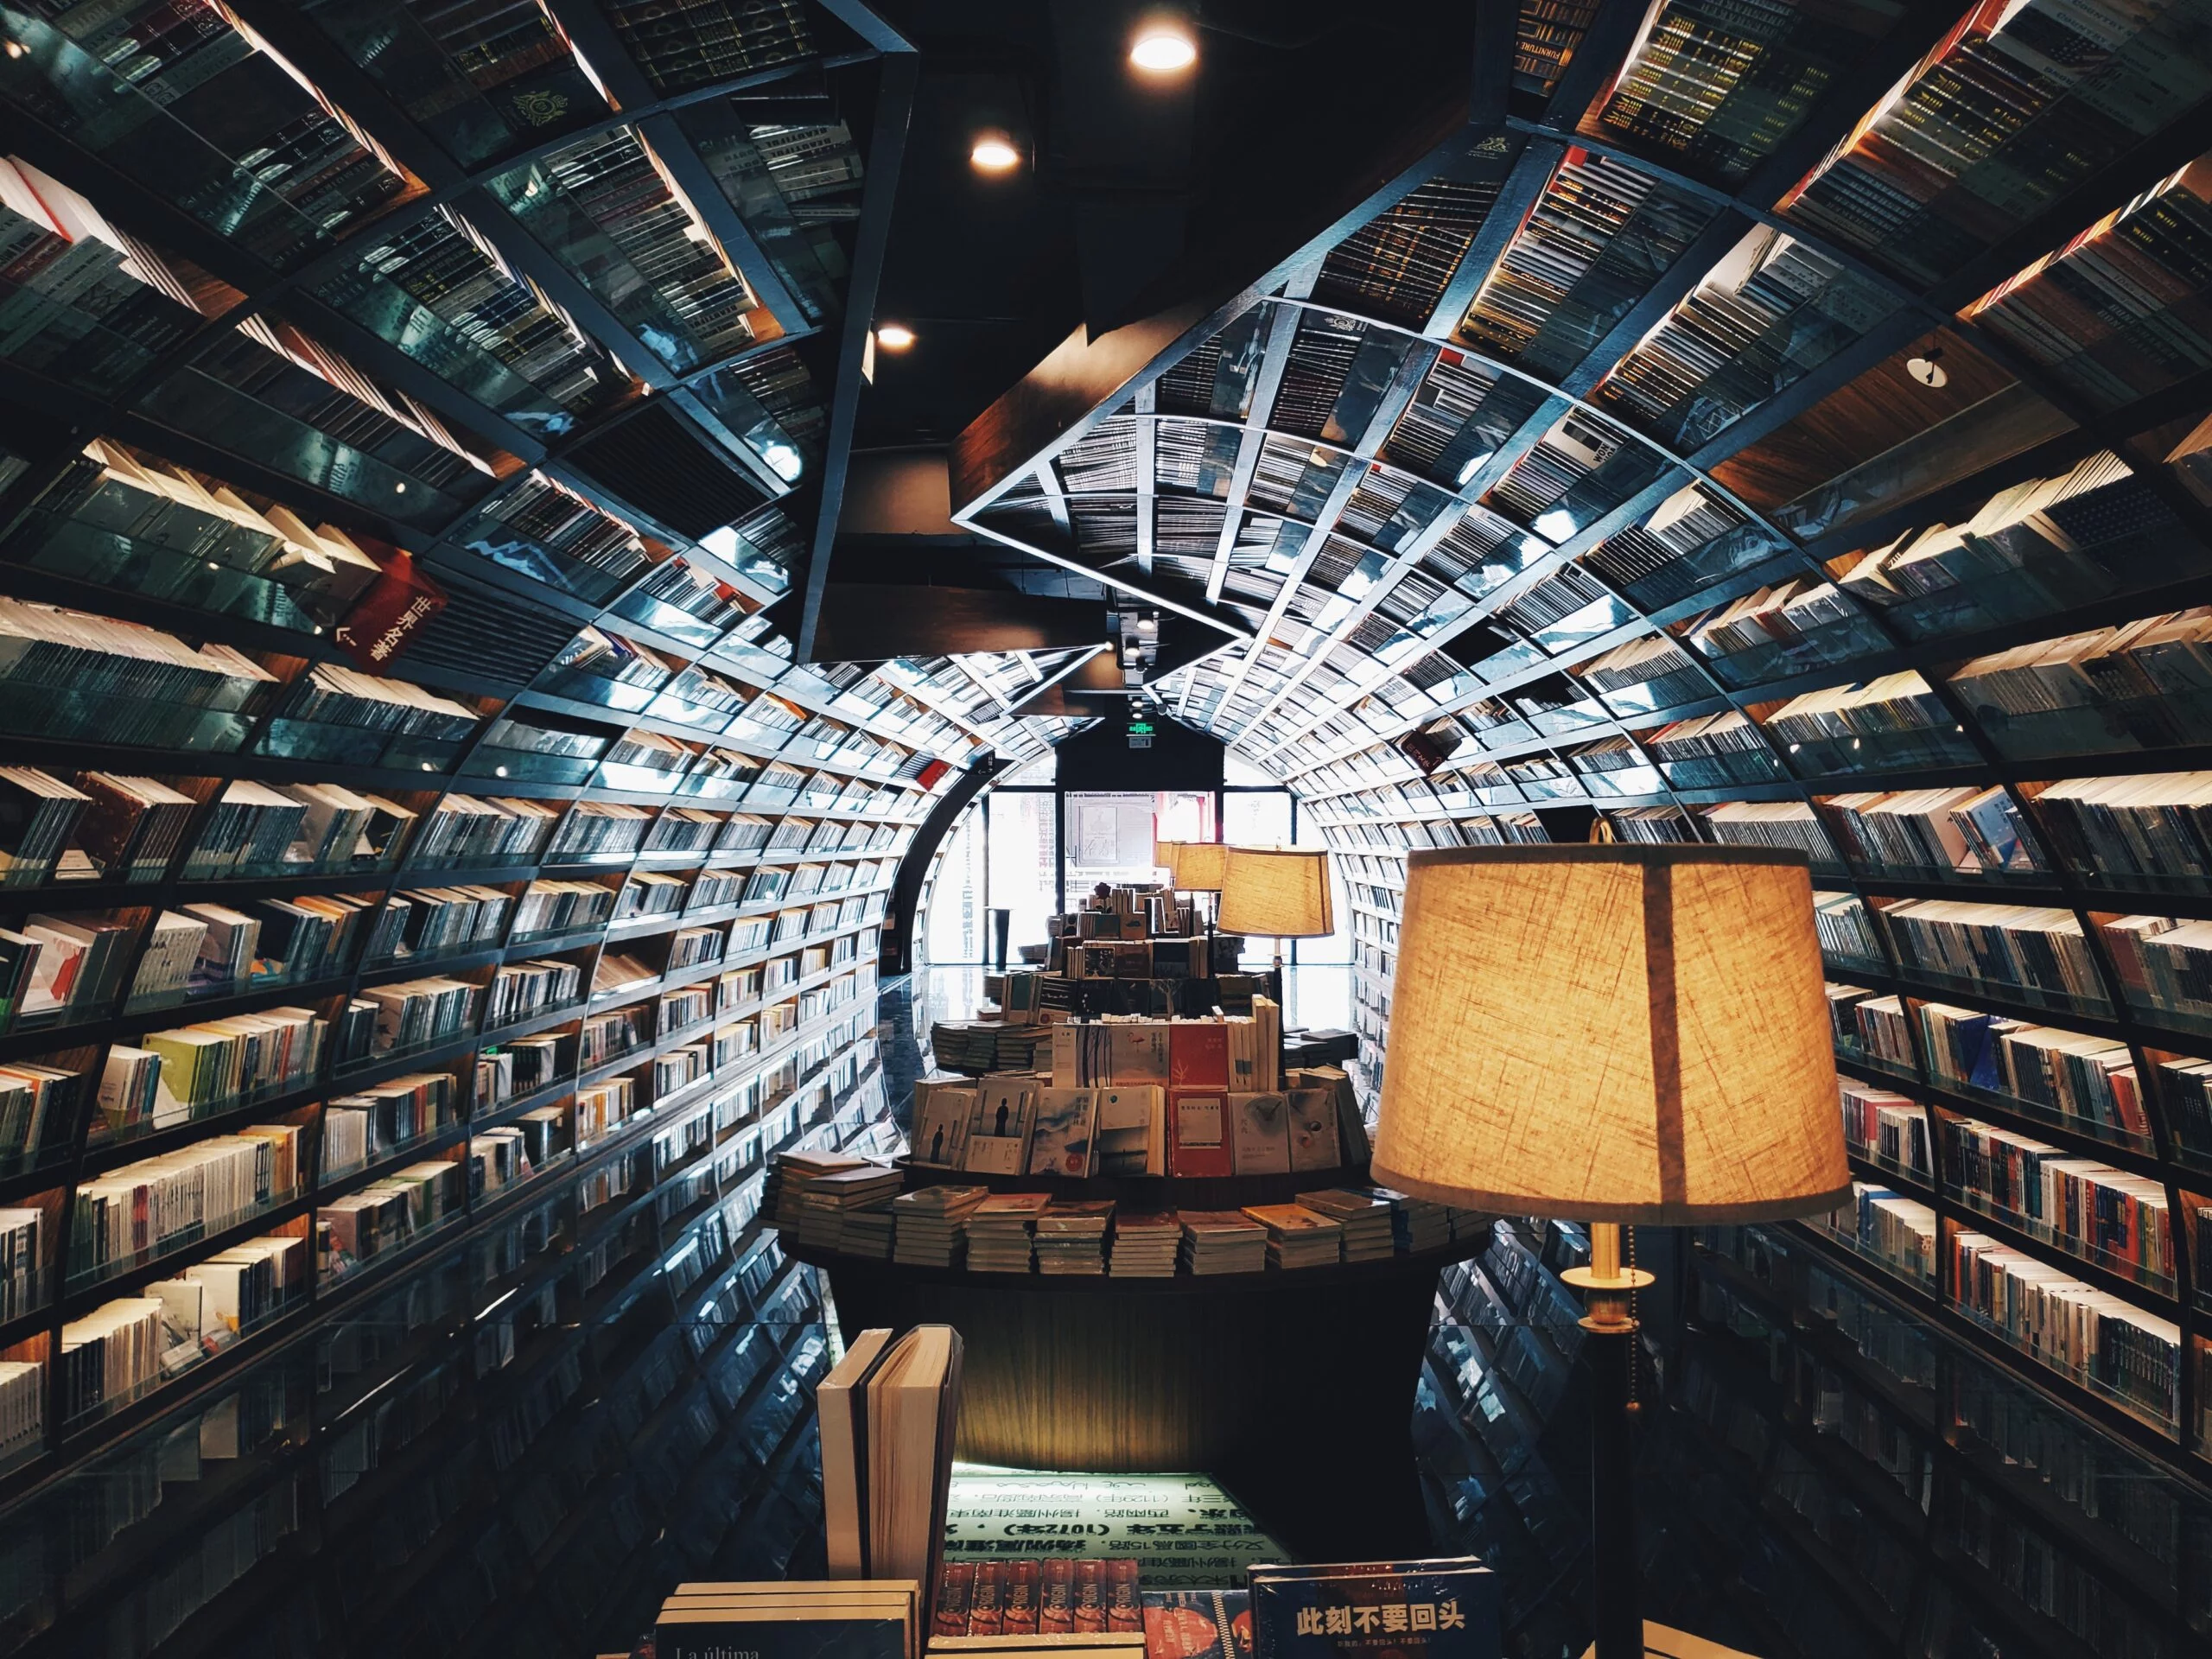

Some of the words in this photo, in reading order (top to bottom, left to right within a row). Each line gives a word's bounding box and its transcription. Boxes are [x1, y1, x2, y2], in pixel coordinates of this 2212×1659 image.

[1520, 41, 1561, 60] FURNITURE
[765, 125, 828, 149] BEAUTIFUL
[770, 137, 831, 159] BEAUTIFUL
[370, 594, 432, 662] 世界名著
[1297, 1601, 1465, 1636] 此刻不要回头
[676, 1647, 698, 1659] La
[704, 1645, 759, 1659] última
